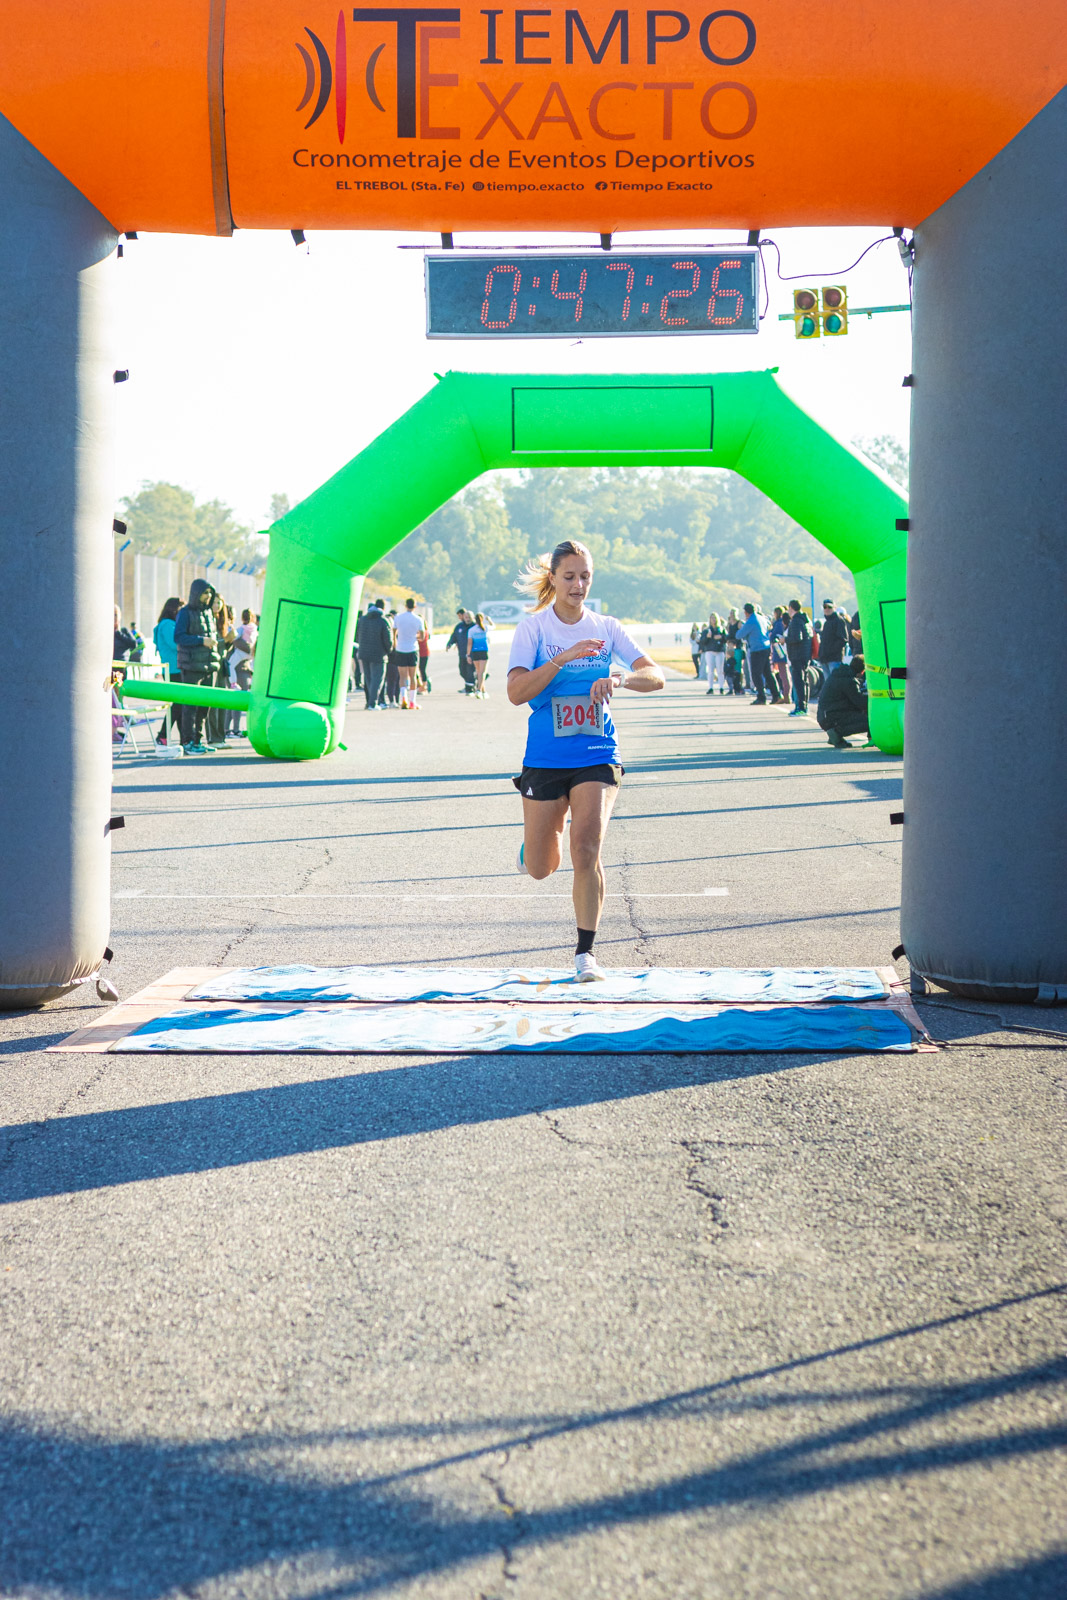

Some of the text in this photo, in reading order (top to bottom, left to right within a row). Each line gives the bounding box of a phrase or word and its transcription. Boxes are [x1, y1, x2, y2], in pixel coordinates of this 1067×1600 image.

[293, 149, 754, 172] Cronometraje de Eventos Deportivos
[336, 181, 465, 192] EL TREBOL (Sta. Fe)
[486, 181, 585, 193] tiempo.exacto
[610, 181, 713, 193] Tiempo Exacto
[480, 261, 743, 329] 0:47:26
[562, 704, 596, 727] 204
